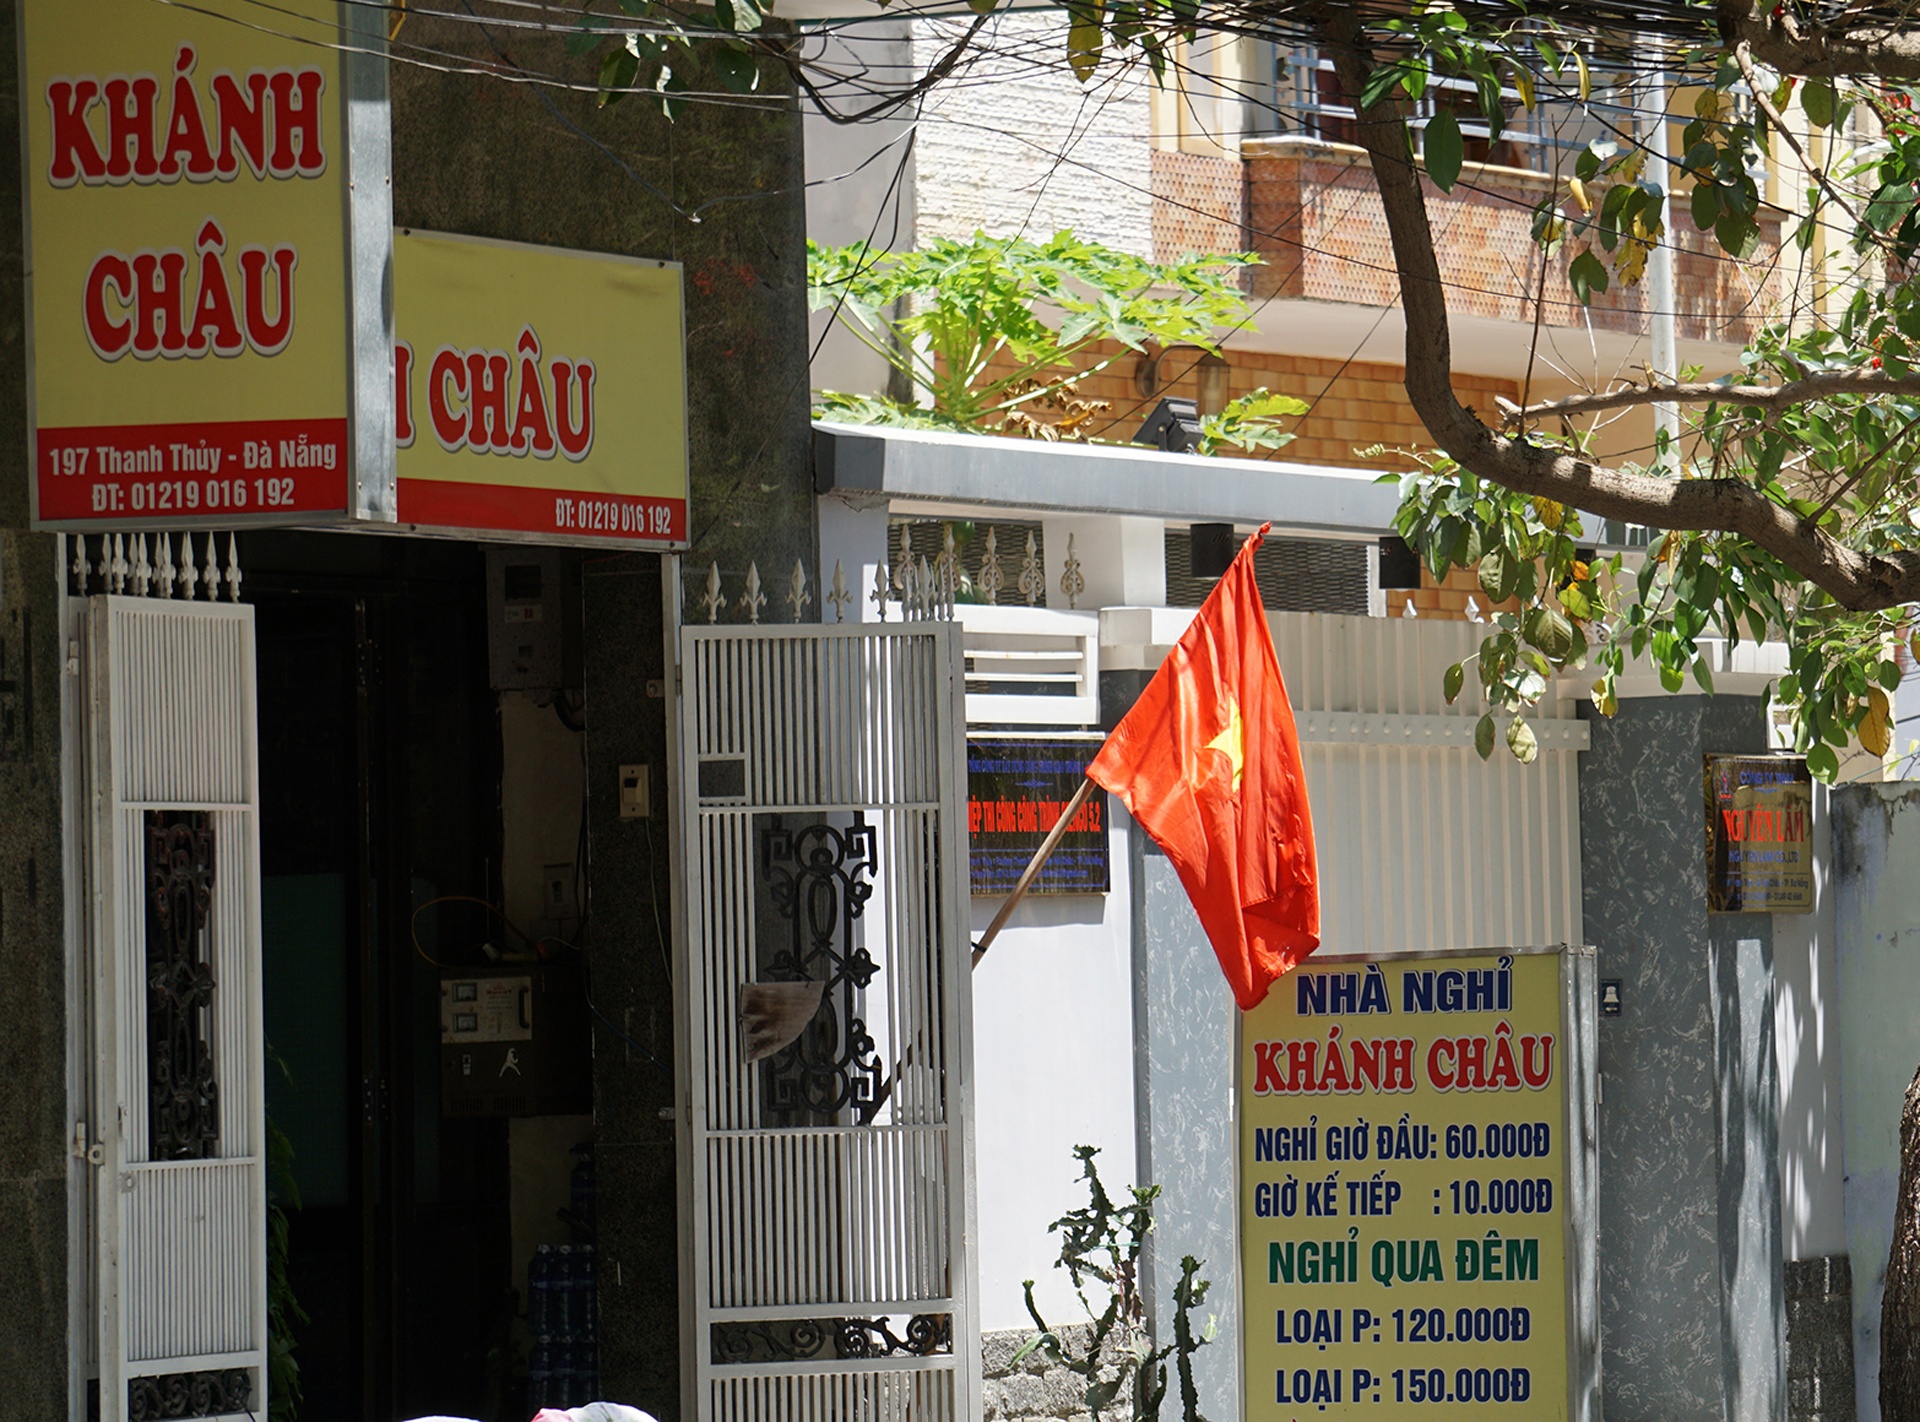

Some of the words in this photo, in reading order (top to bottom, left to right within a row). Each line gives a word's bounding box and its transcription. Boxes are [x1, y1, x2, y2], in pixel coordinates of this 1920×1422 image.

[46, 40, 326, 187] KHÁNH
[83, 215, 298, 361] CHÂU
[426, 323, 595, 461] CHÂU
[50, 448, 89, 475] 197
[97, 446, 163, 474] Thanh
[170, 440, 221, 474] Thủy
[244, 440, 272, 469] Đà
[280, 434, 336, 470] Nẵng
[92, 484, 124, 512] ĐT:
[131, 481, 199, 510] 01219
[206, 480, 246, 507] 016
[254, 478, 294, 506] 192
[556, 498, 575, 527] ĐT:
[578, 500, 618, 531] 01219
[622, 503, 644, 532] 016
[648, 505, 671, 534] 192
[1722, 803, 1773, 842] NGUYÊN
[1776, 804, 1804, 842] LÂM
[1296, 963, 1391, 1015] NHÀ
[1402, 955, 1513, 1014] NGHỈ
[1253, 1024, 1416, 1096] KHÁNH
[1426, 1018, 1555, 1093] CHÂU
[1255, 1115, 1317, 1161] NGHỈ
[1325, 1117, 1369, 1161] GIỜ
[1377, 1112, 1437, 1160] ĐẦU:
[1445, 1122, 1551, 1158] 60.000Đ
[1255, 1173, 1298, 1217] GIỜ
[1305, 1171, 1339, 1217] KẾ
[1346, 1170, 1401, 1216] TIẾP
[1450, 1178, 1553, 1215] 10.000Đ
[1268, 1226, 1359, 1284] NGHỈ
[1371, 1239, 1444, 1288] QUA
[1455, 1230, 1539, 1282] ĐÊM
[1276, 1309, 1342, 1350] LOẠI
[1352, 1308, 1380, 1343] P:
[1391, 1306, 1531, 1342] 120.000Đ
[1276, 1369, 1342, 1411] LOẠI
[1352, 1368, 1381, 1404] P:
[1391, 1367, 1531, 1403] 150.000Đ
